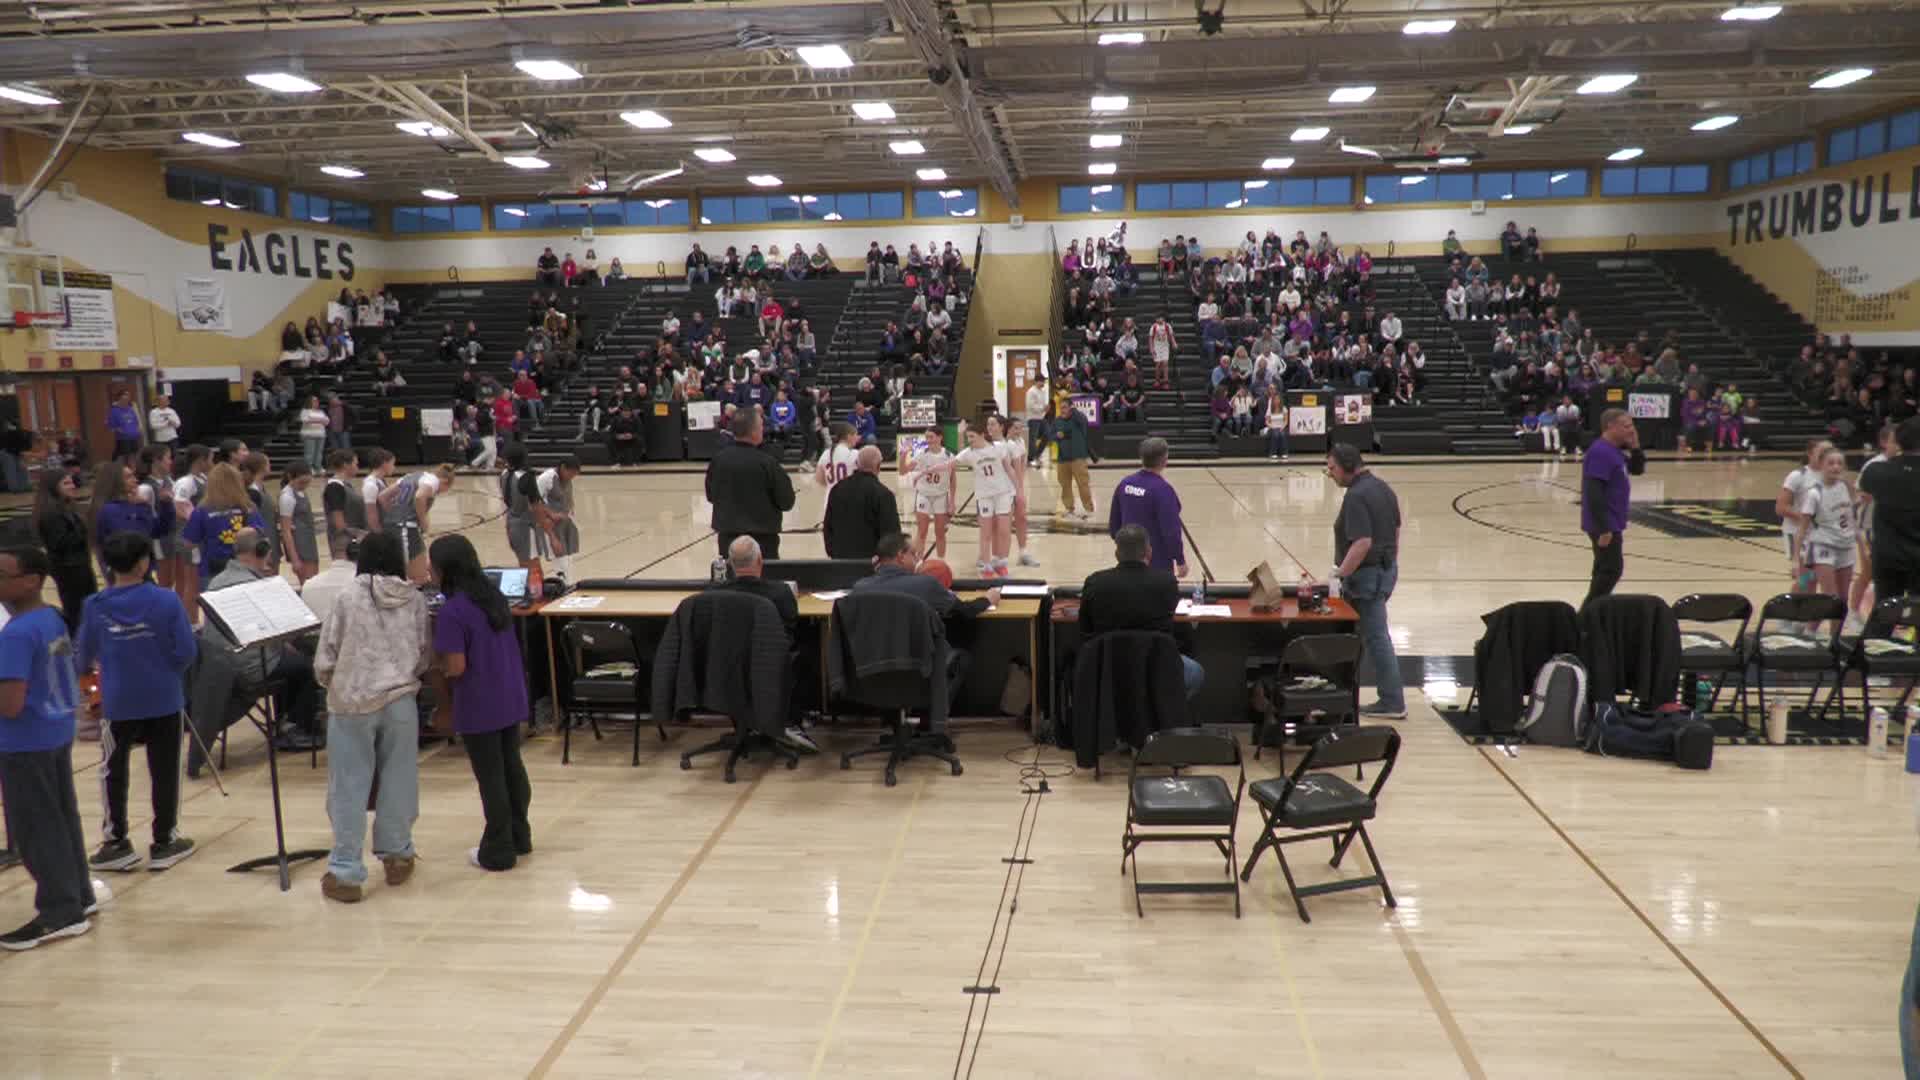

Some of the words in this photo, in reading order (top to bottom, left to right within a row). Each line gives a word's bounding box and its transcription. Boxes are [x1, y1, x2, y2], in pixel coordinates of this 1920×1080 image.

[208, 223, 354, 281] EAGLES
[826, 462, 847, 484] 30
[983, 464, 994, 476] 11
